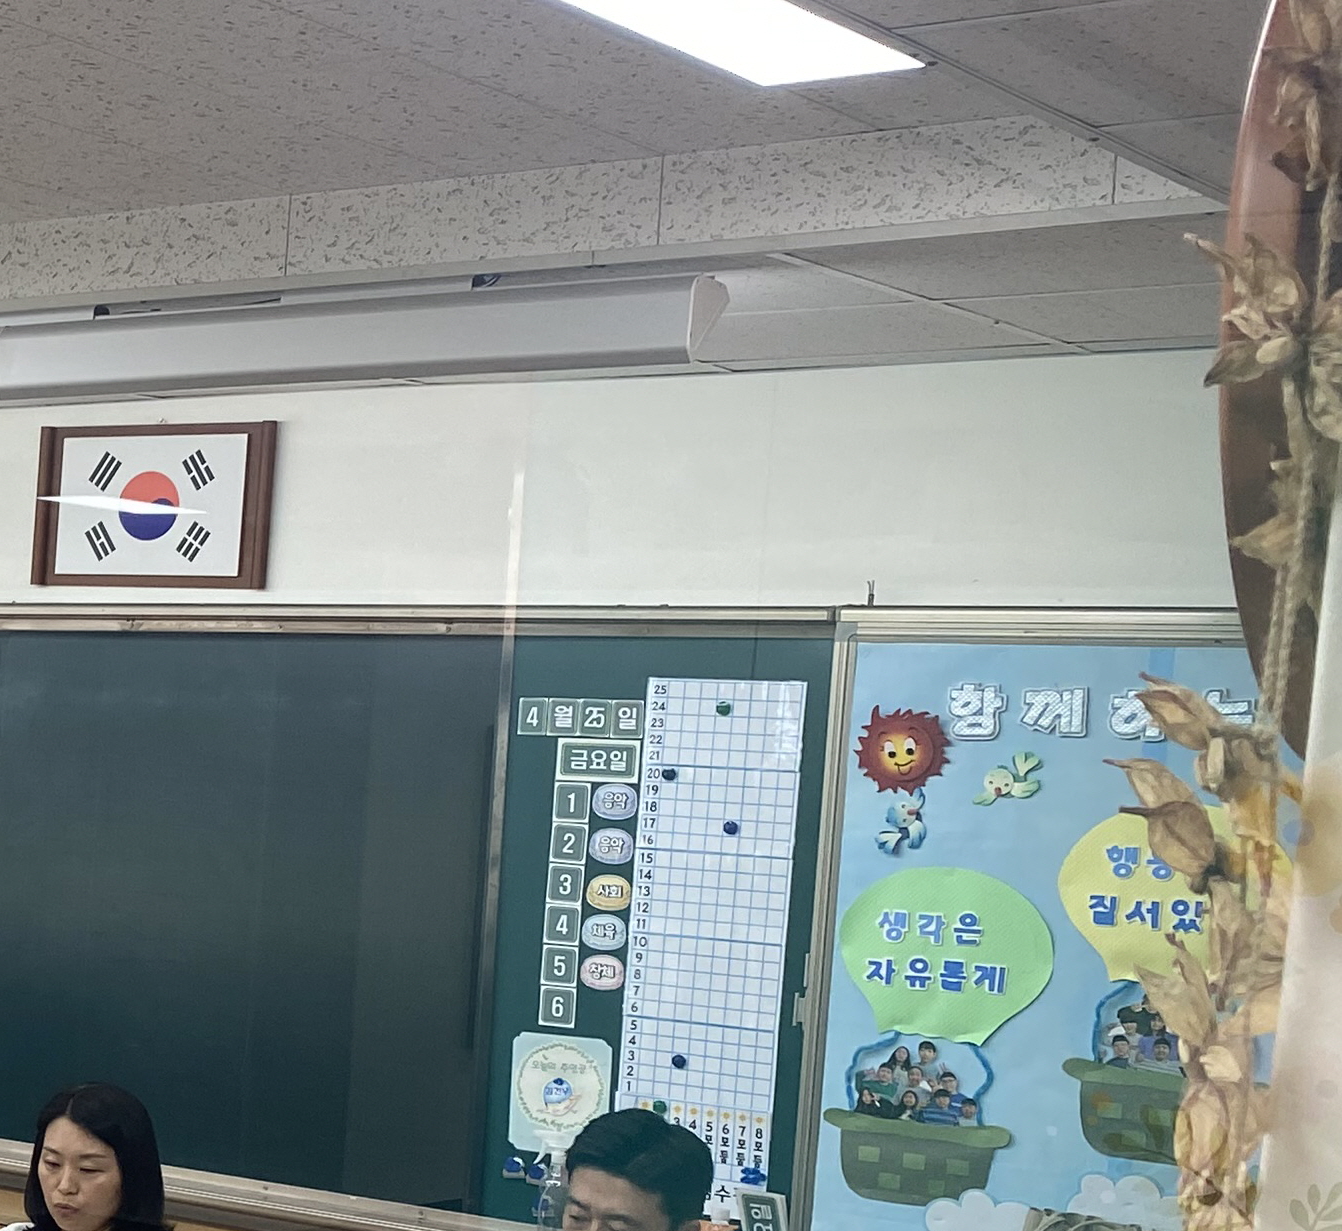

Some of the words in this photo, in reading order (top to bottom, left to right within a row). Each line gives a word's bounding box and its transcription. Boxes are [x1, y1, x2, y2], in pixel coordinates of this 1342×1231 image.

[654, 685, 667, 694] 25
[652, 701, 666, 711] 24
[651, 718, 664, 727] 23
[649, 735, 662, 744] 22
[570, 749, 627, 772] 금요일
[649, 751, 660, 760] 21
[647, 768, 660, 779] 20
[646, 785, 658, 795] 19
[567, 792, 575, 813] 1
[644, 802, 657, 812] 18
[643, 818, 656, 828] 17
[562, 833, 575, 854] 2
[642, 834, 654, 844] 16
[640, 853, 653, 864] 15
[639, 870, 652, 880] 14
[559, 874, 572, 895] 3
[597, 884, 623, 898] 사회
[638, 886, 650, 896] 13
[637, 902, 649, 913] 12
[556, 914, 568, 935] 4
[591, 923, 616, 940] 체육
[636, 919, 646, 929] 11
[878, 911, 983, 945] 생각은
[633, 936, 647, 947] 10
[636, 952, 643, 963] 9
[553, 955, 566, 976] 5
[588, 963, 616, 980] 창체
[634, 969, 641, 980] 8
[866, 958, 1007, 994] 자유롭게
[633, 985, 640, 996] 7
[551, 997, 565, 1018] 6
[631, 1002, 638, 1013] 6
[630, 1020, 637, 1030] 5
[629, 1035, 636, 1045] 4
[628, 1050, 635, 1061] 3
[627, 1066, 634, 1076] 2
